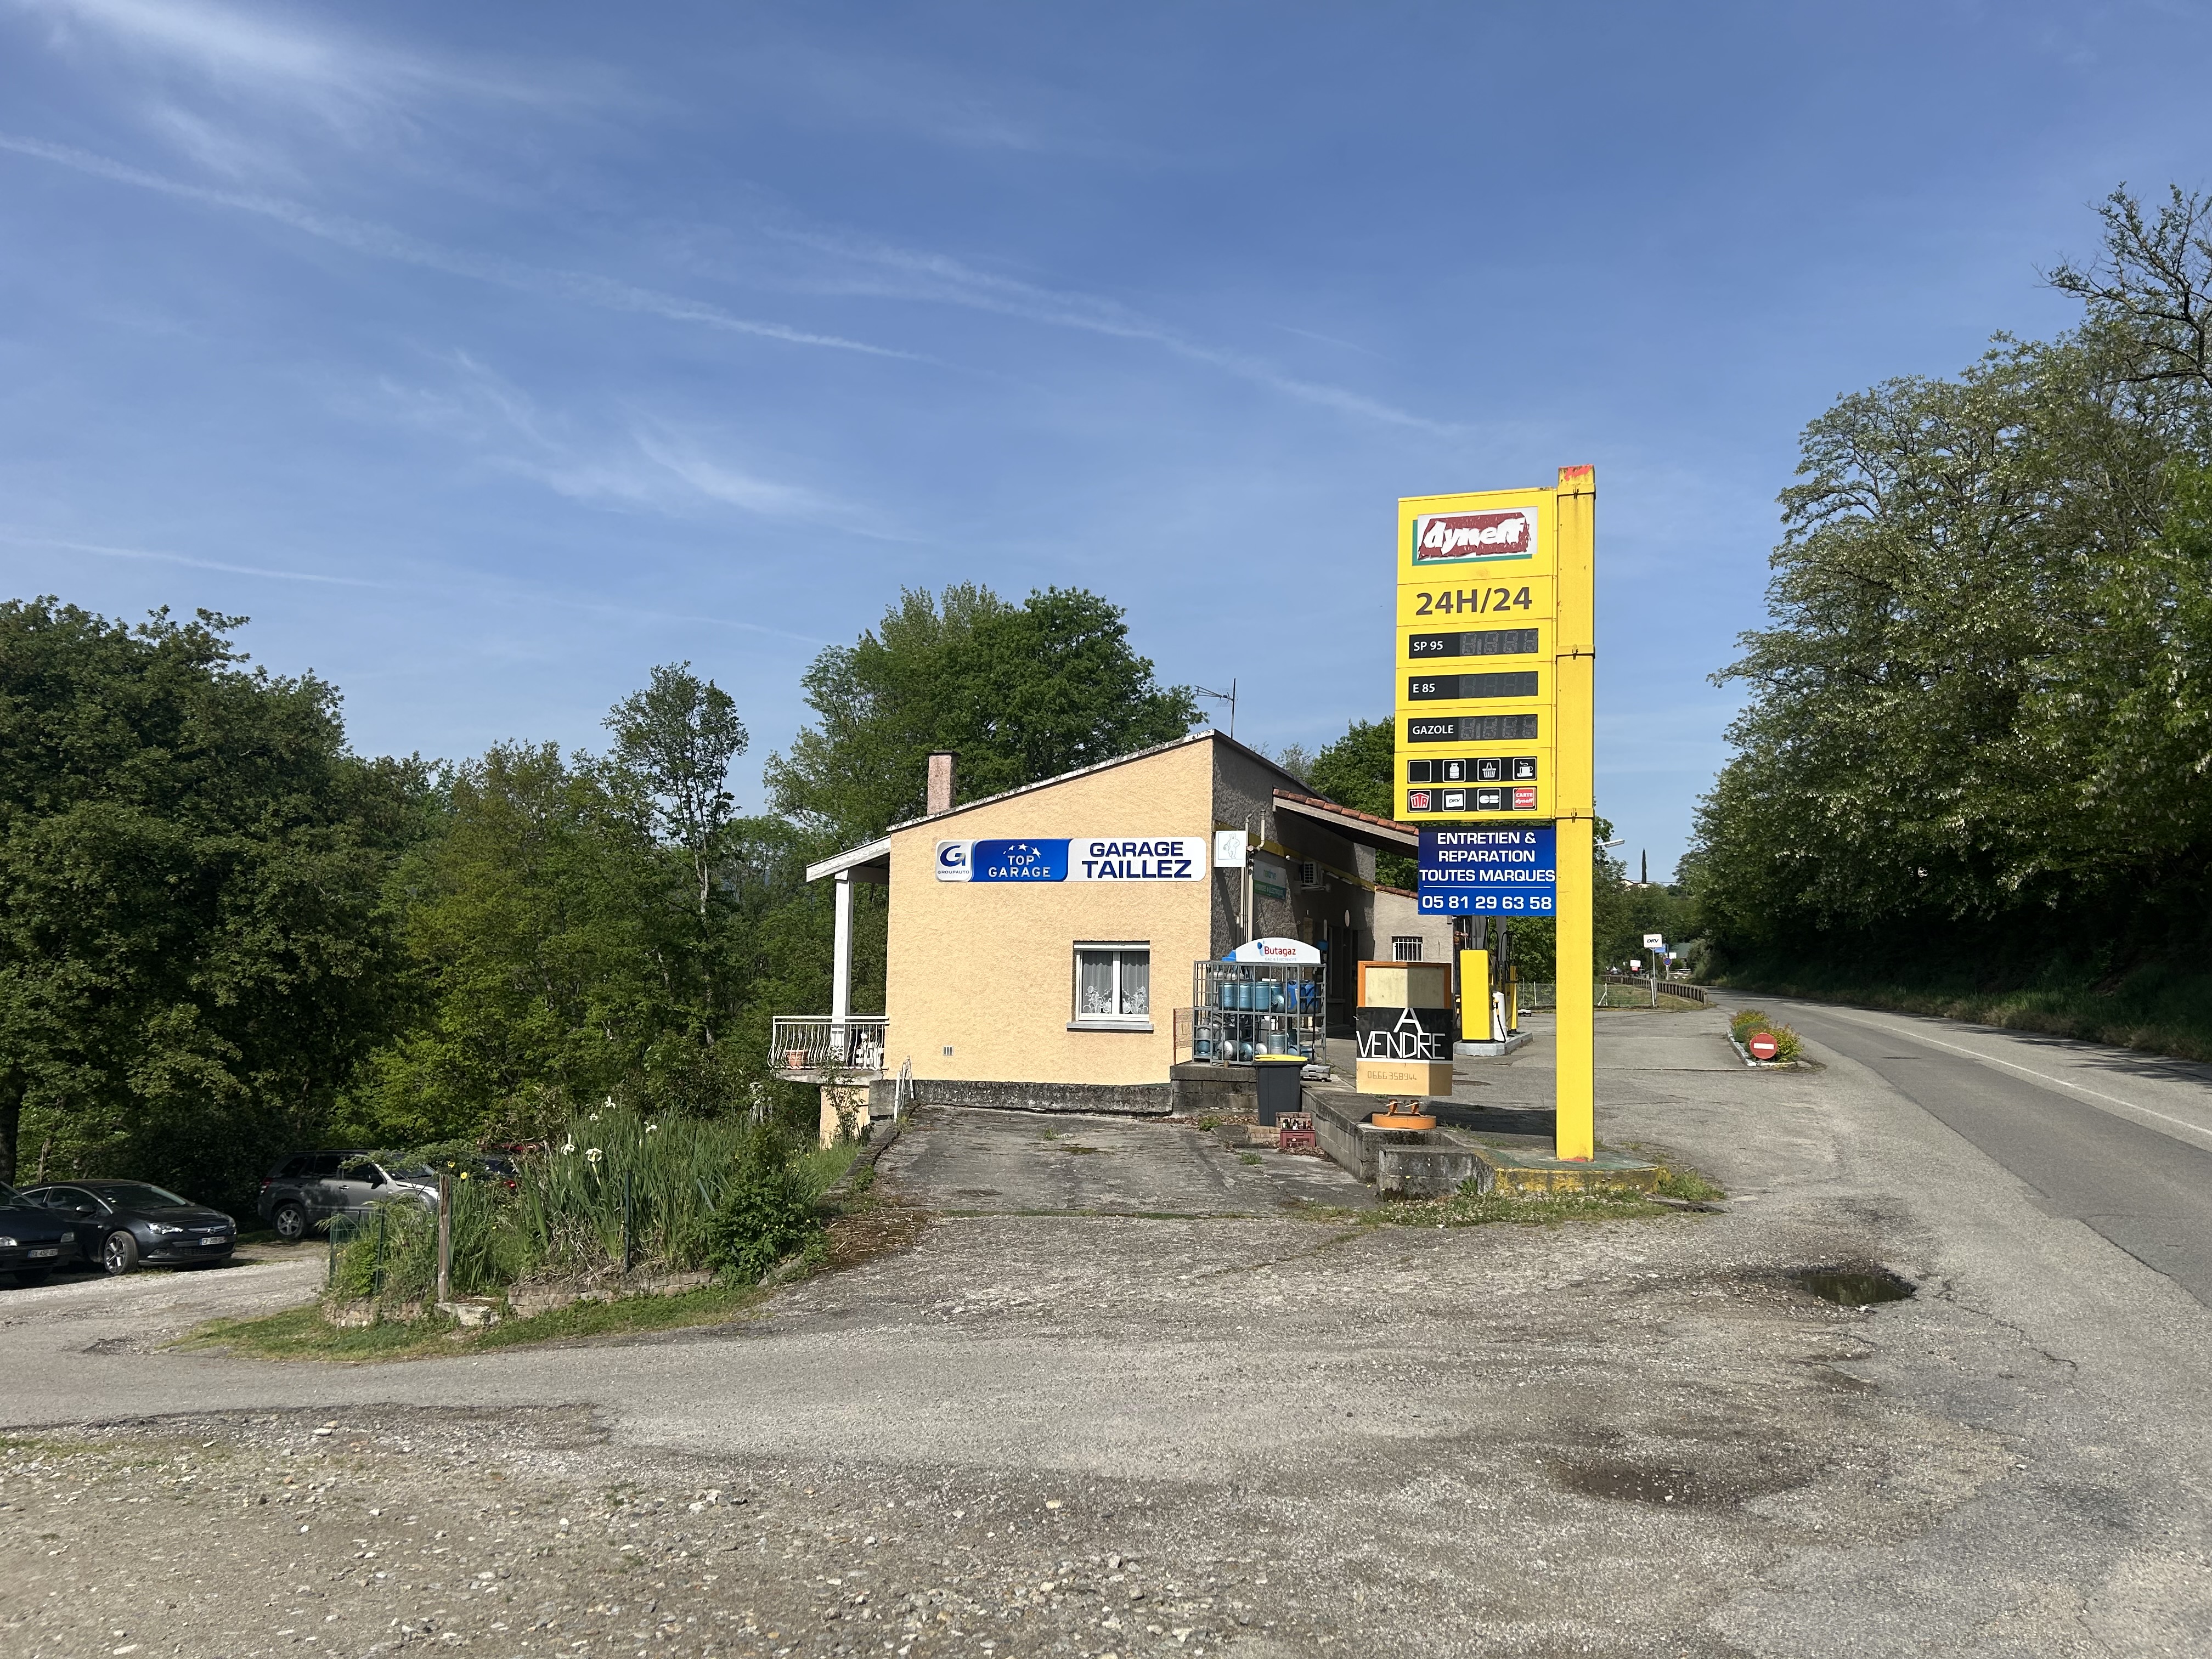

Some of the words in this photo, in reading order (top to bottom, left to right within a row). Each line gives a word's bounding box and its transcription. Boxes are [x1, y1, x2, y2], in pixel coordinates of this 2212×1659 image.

[1415, 587, 1532, 616] 24H/24
[1414, 641, 1427, 651] SP
[1430, 641, 1443, 651] 95
[1413, 684, 1419, 693] E
[1422, 684, 1435, 693] 85
[1412, 725, 1454, 735] GAZOLE
[1437, 832, 1520, 844] ENTRETIEN
[1525, 832, 1536, 844] &
[1090, 842, 1184, 857] GARAGE
[1007, 855, 1035, 866] TOP
[1438, 850, 1536, 862] REPARATION
[988, 866, 1051, 878] GARAGE
[1081, 860, 1192, 878] TAILLEZ
[1419, 869, 1475, 882] TOUTES
[1480, 870, 1555, 882] MARQUES
[1422, 896, 1443, 909] 05
[1448, 896, 1468, 909] 81
[1475, 896, 1497, 909] 29
[1502, 896, 1524, 909] 63
[1530, 896, 1552, 910] 58
[1264, 946, 1296, 957] Butagaz
[1393, 1007, 1424, 1034] A
[1356, 1030, 1446, 1059] VENDRE
